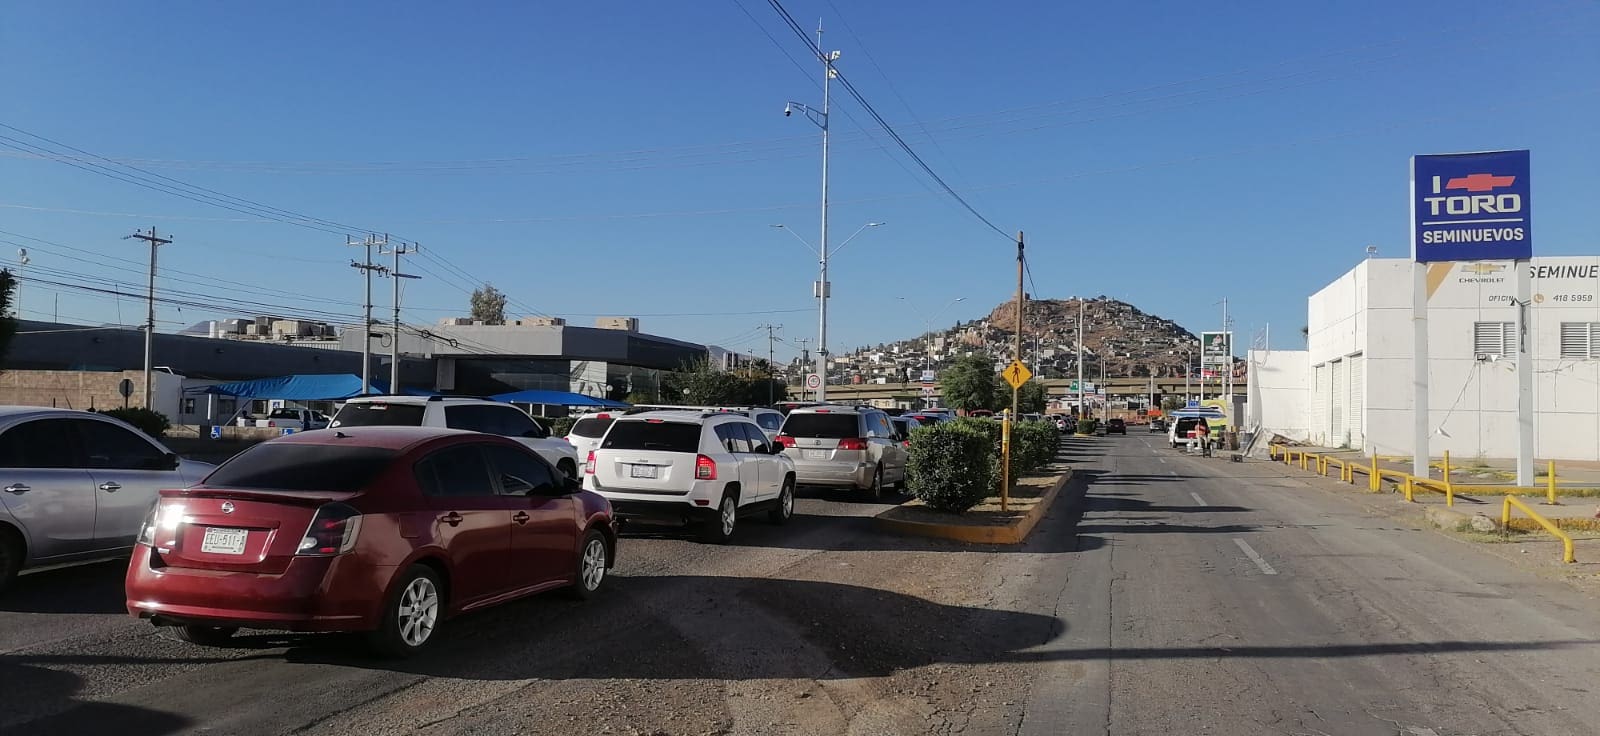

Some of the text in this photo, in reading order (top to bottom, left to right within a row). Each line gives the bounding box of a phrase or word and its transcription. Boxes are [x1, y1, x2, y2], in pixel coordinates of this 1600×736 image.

[1432, 175, 1441, 194] I
[1424, 194, 1521, 215] TORO
[1423, 228, 1524, 243] SEMINUEVOS
[1553, 294, 1593, 302] 418 5959
